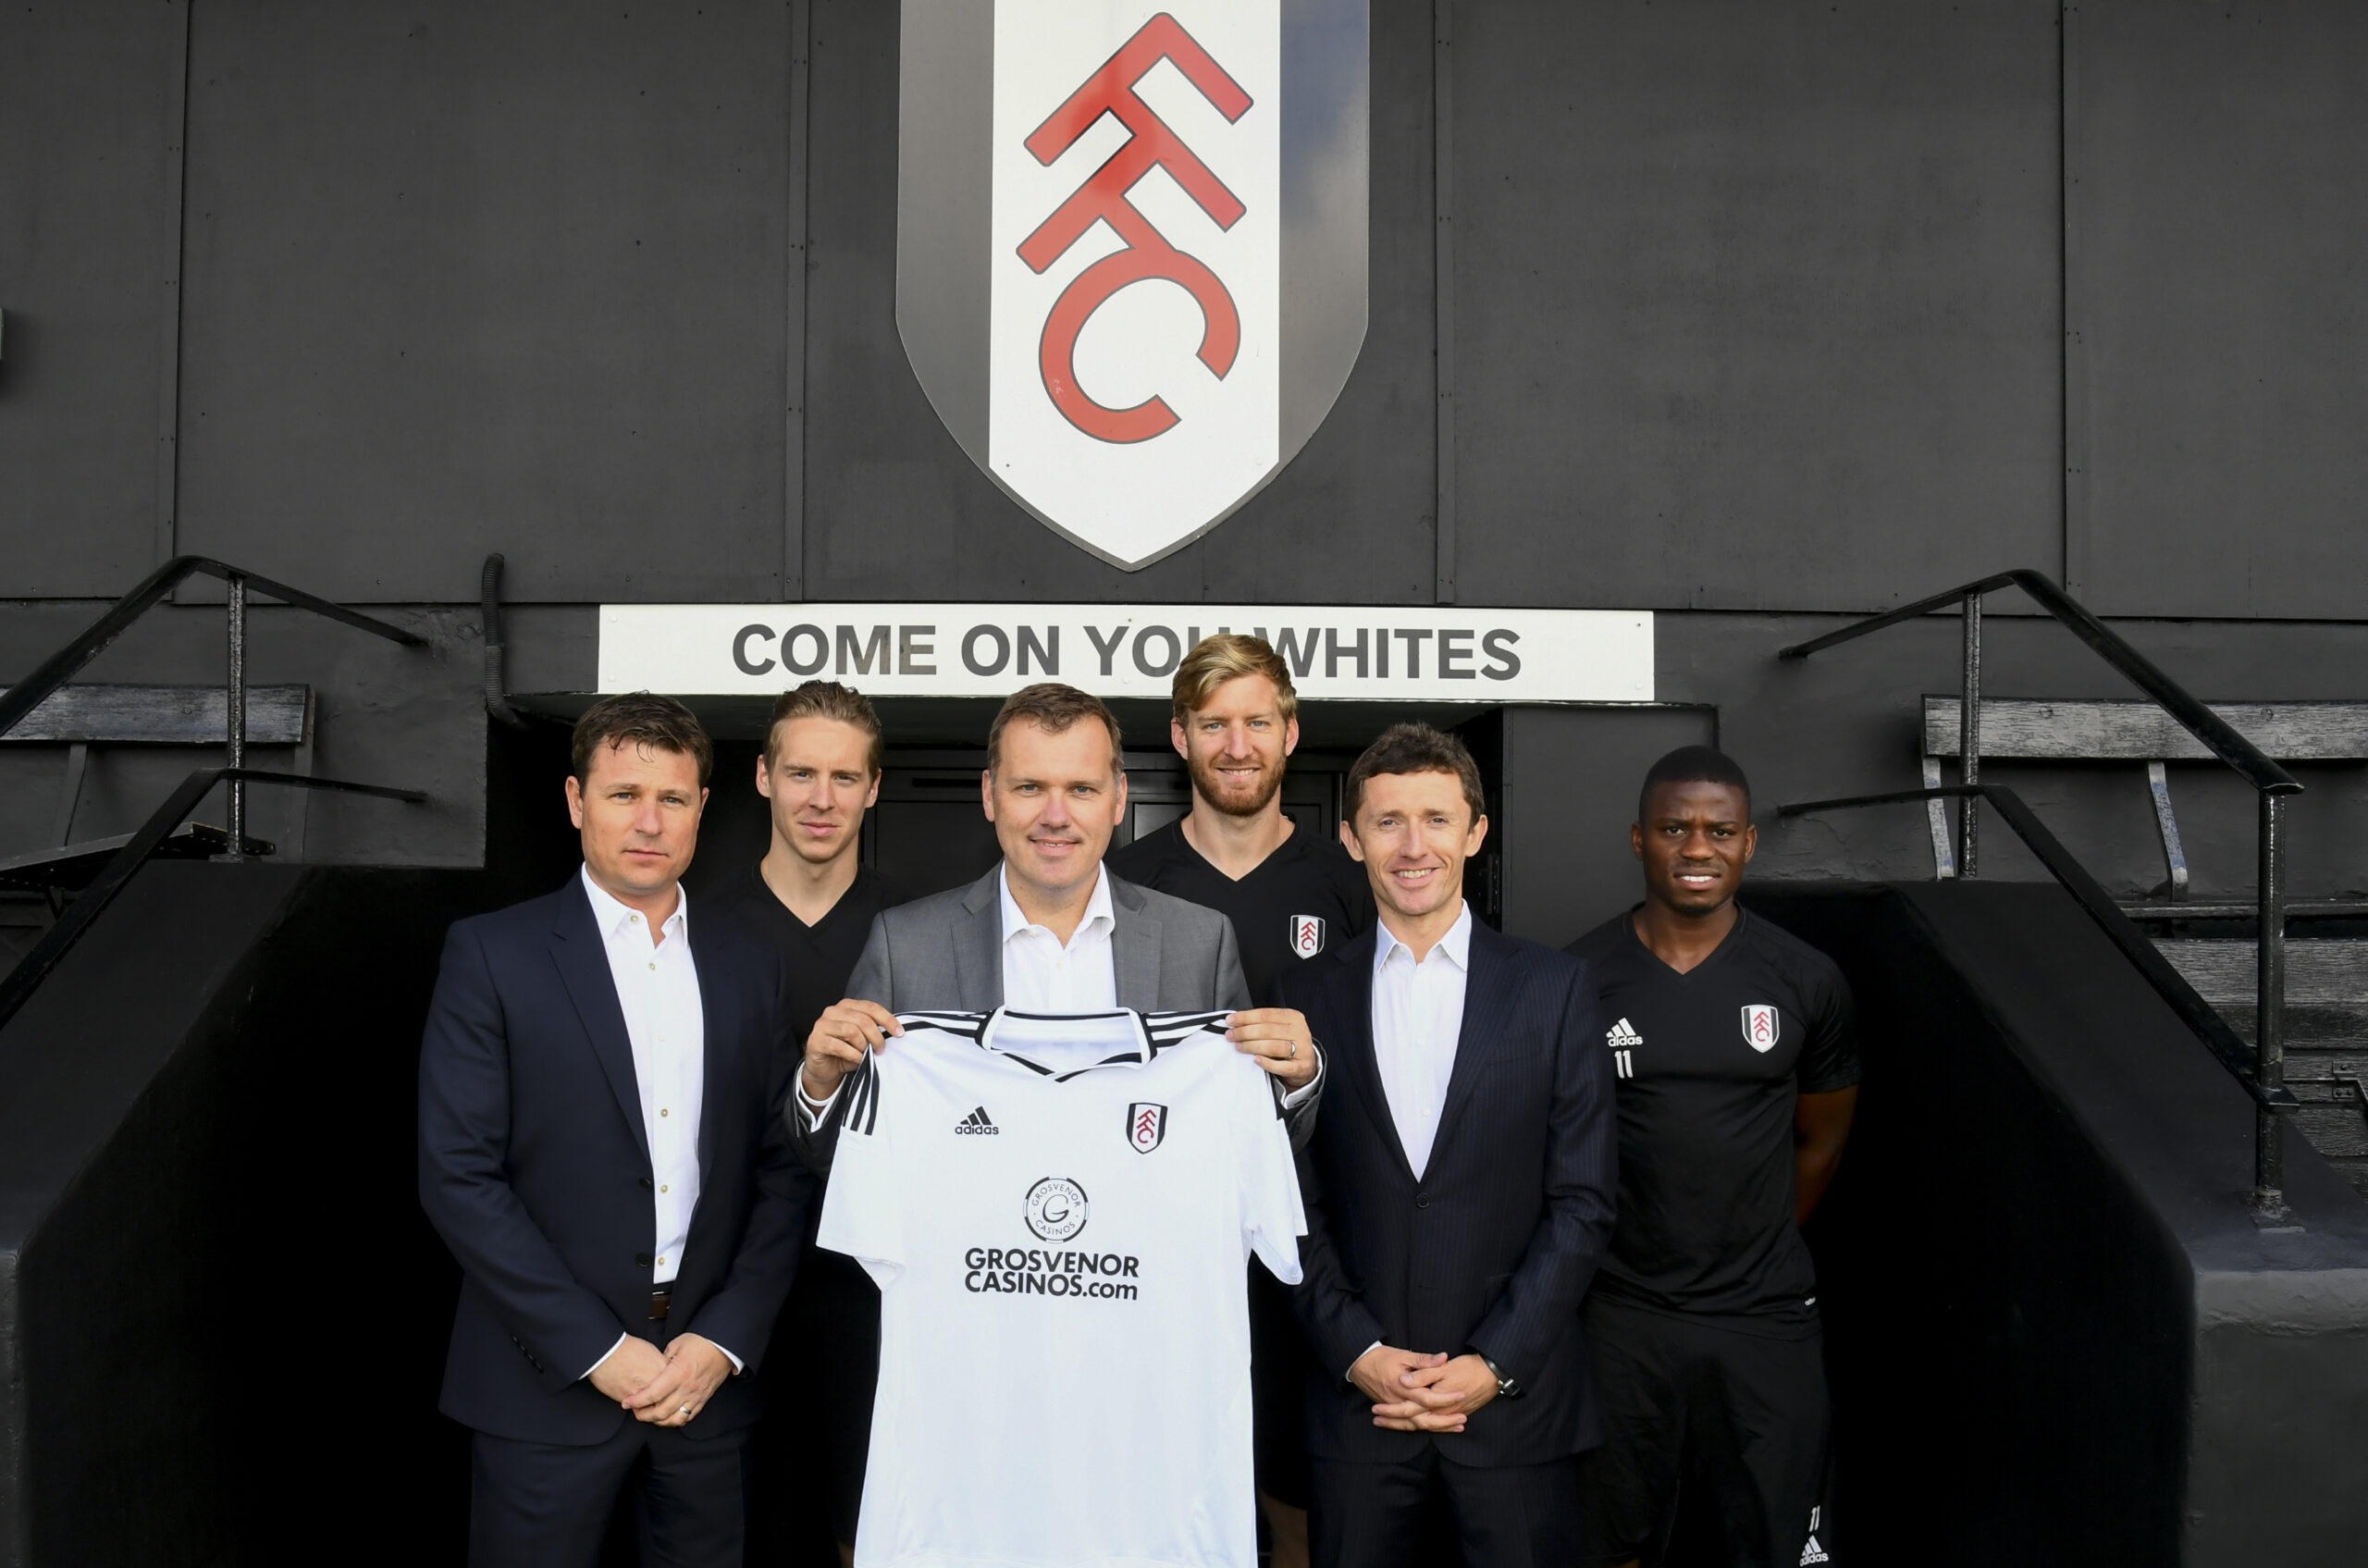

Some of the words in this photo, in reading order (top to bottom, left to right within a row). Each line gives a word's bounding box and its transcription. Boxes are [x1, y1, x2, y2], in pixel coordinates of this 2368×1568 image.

[733, 623, 937, 676] COME
[961, 623, 1061, 677] ON
[1083, 624, 1231, 677] YO
[1253, 626, 1522, 681] WHITES
[1608, 1034, 1644, 1047] didas
[1614, 1050, 1634, 1079] 11
[955, 1124, 1000, 1135] adidas
[1031, 1183, 1081, 1208] GROSVENOR
[1035, 1219, 1076, 1236] CASINOS
[965, 1247, 1140, 1278] GROSVENOR
[965, 1270, 1138, 1301] CASINOS.com
[1799, 1553, 1829, 1567] adidas
